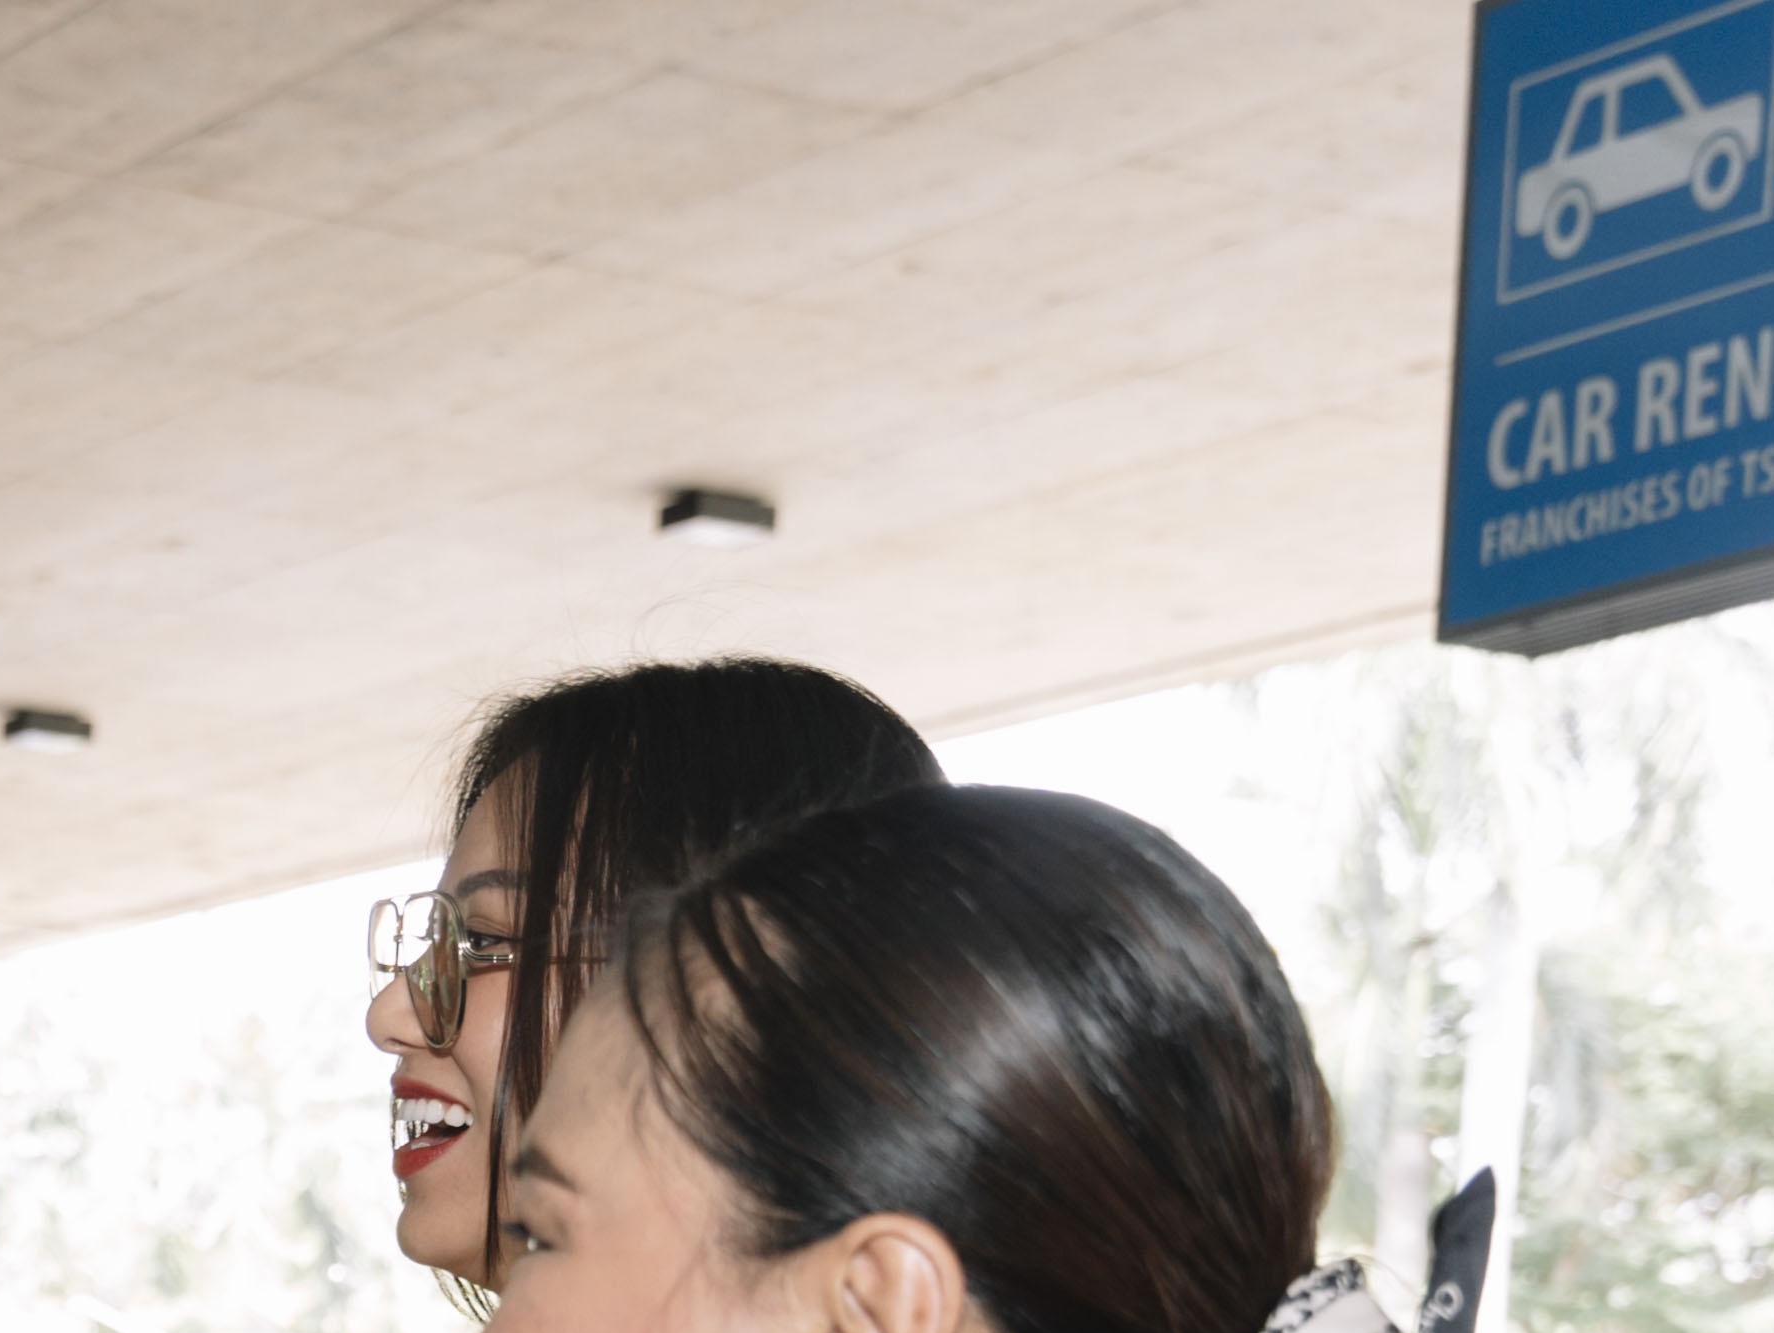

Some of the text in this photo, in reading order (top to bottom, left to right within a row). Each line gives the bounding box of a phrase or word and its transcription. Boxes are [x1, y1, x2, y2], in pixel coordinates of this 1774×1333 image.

[1486, 374, 1618, 491] CAR
[1479, 469, 1682, 567] FRANCHISES
[1686, 460, 1732, 512] OF
